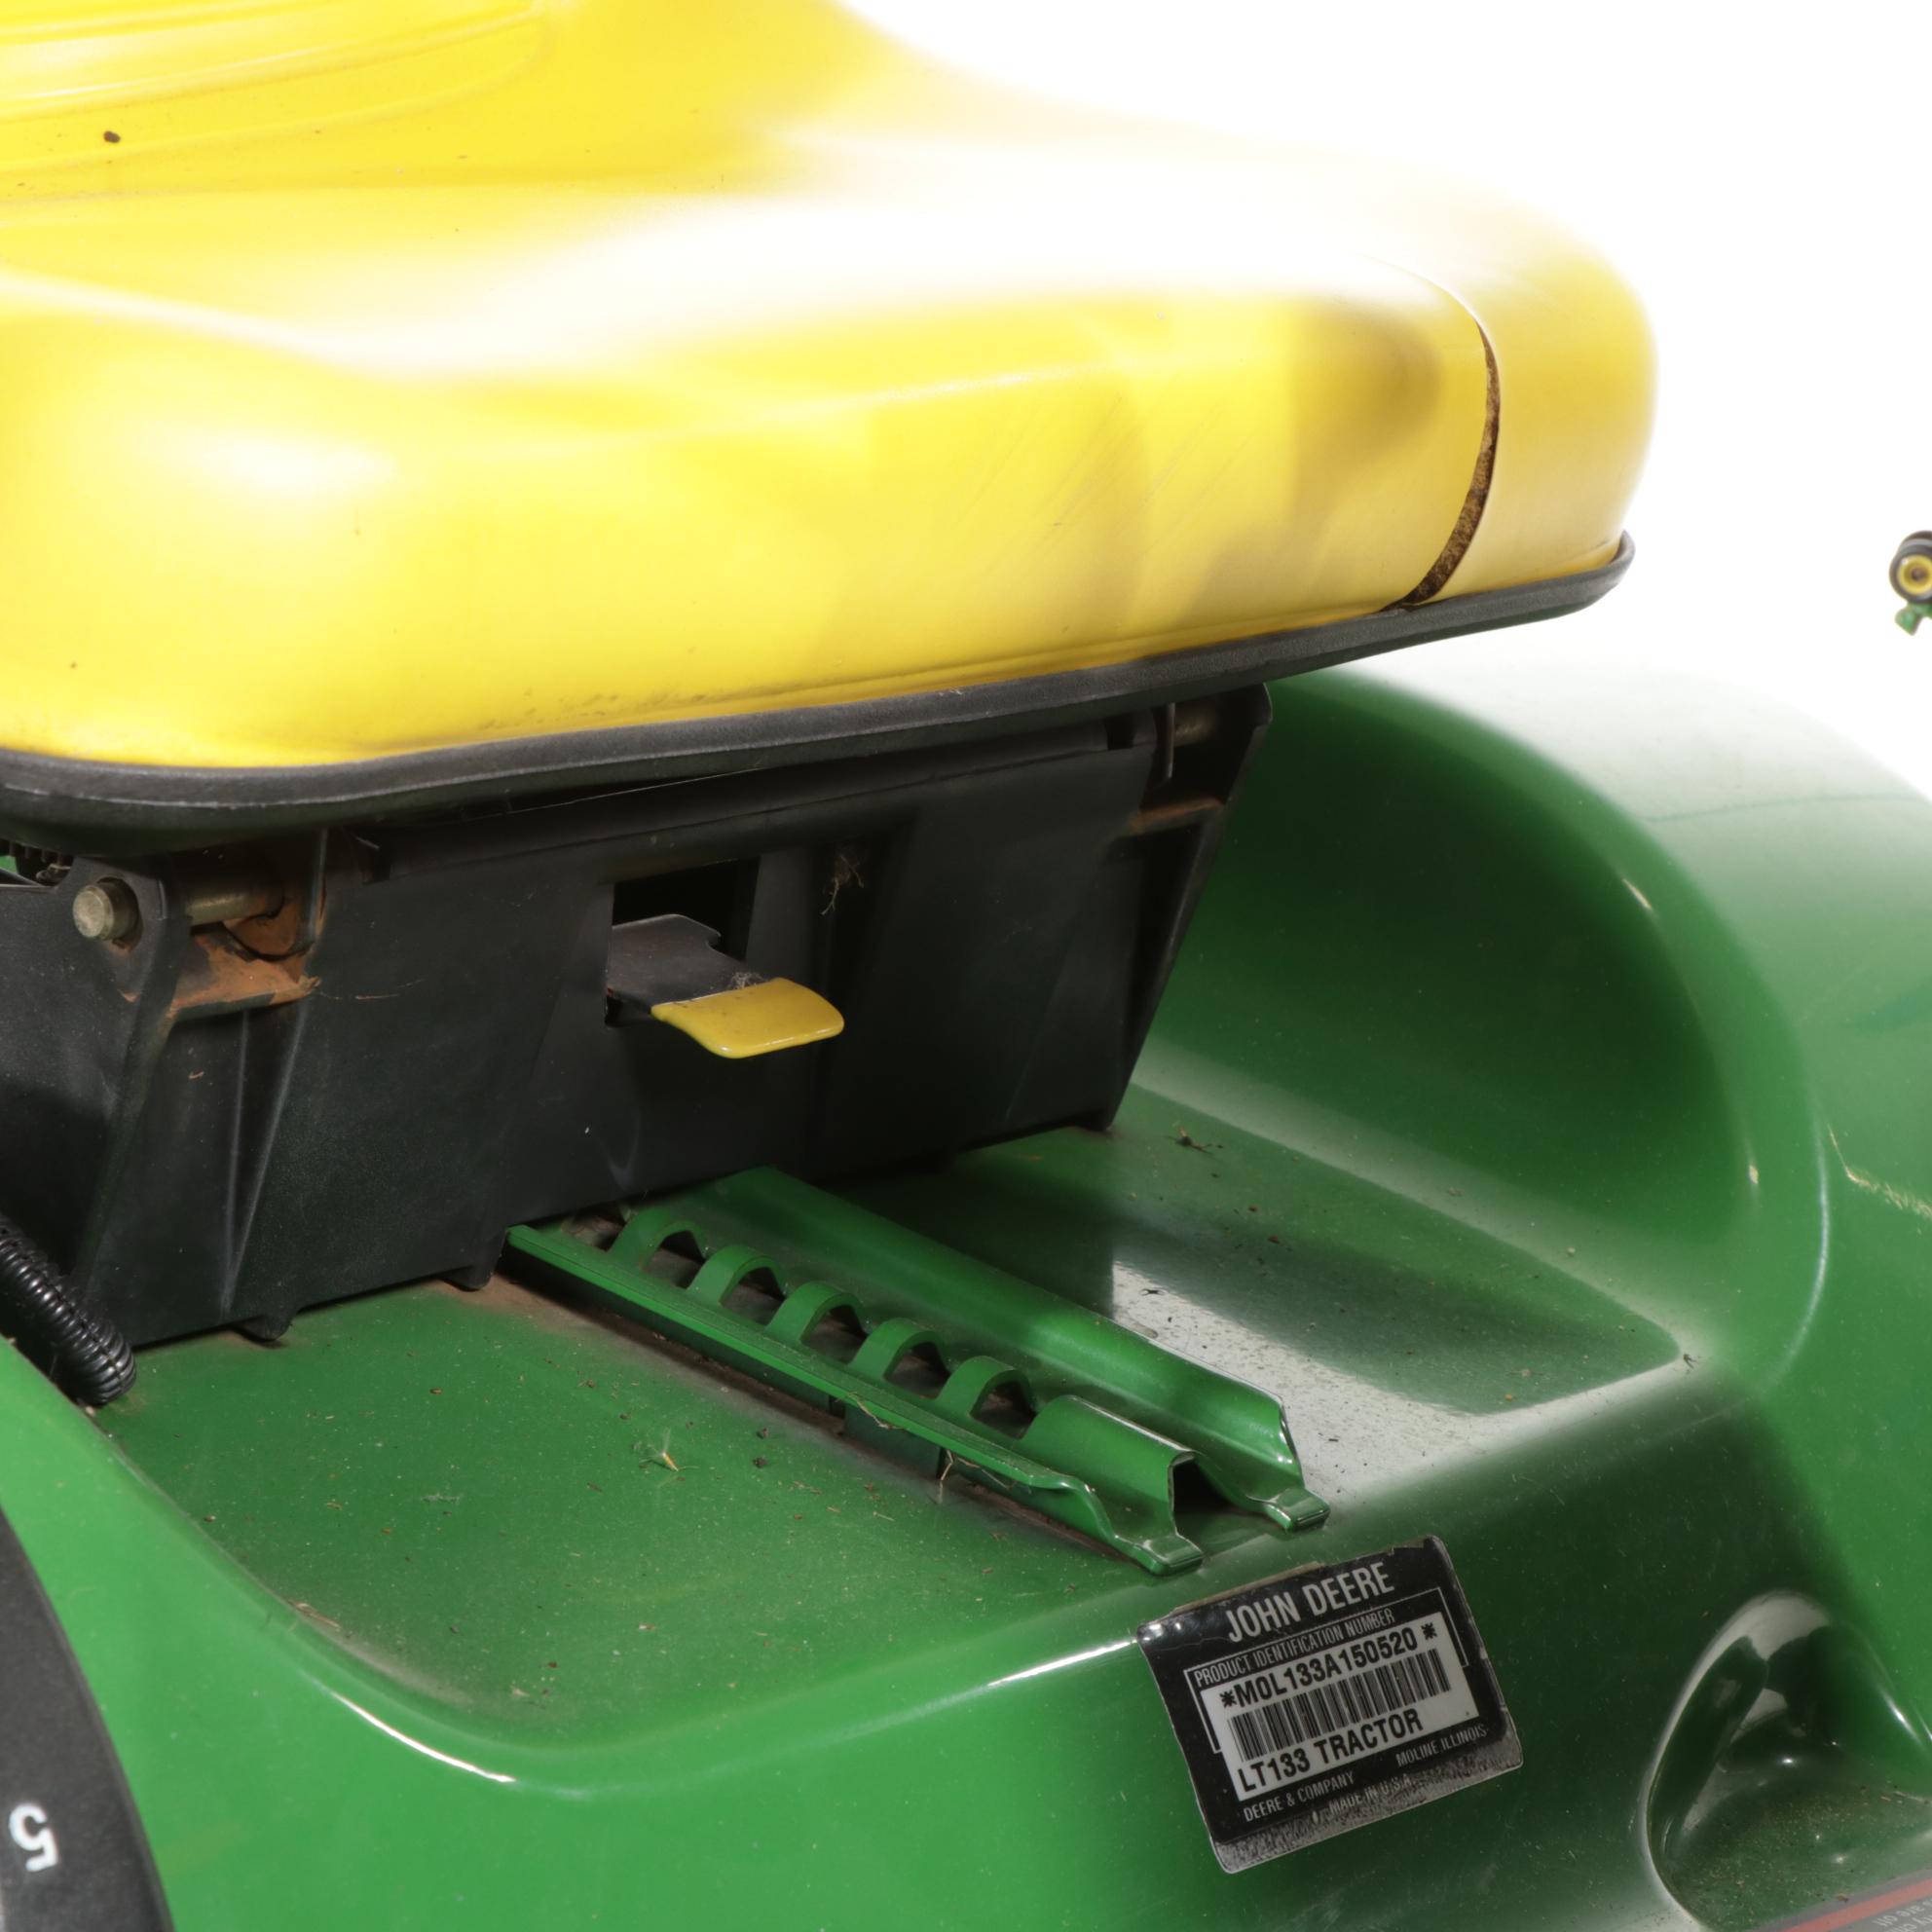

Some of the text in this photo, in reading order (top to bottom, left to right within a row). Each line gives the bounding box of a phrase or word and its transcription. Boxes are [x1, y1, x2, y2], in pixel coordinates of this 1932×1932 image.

[1226, 1562, 1394, 1643] JOHN DEERE
[1195, 1608, 1396, 1689] PRODUCT IDENTIFICATION NUMBER
[1238, 1708, 1424, 1793] LT133 TRACTOR
[1395, 1724, 1488, 1767] MOLINE ILLINOIS
[1243, 1770, 1356, 1822] DEERE & COMPANY
[8, 1802, 58, 1872] 5
